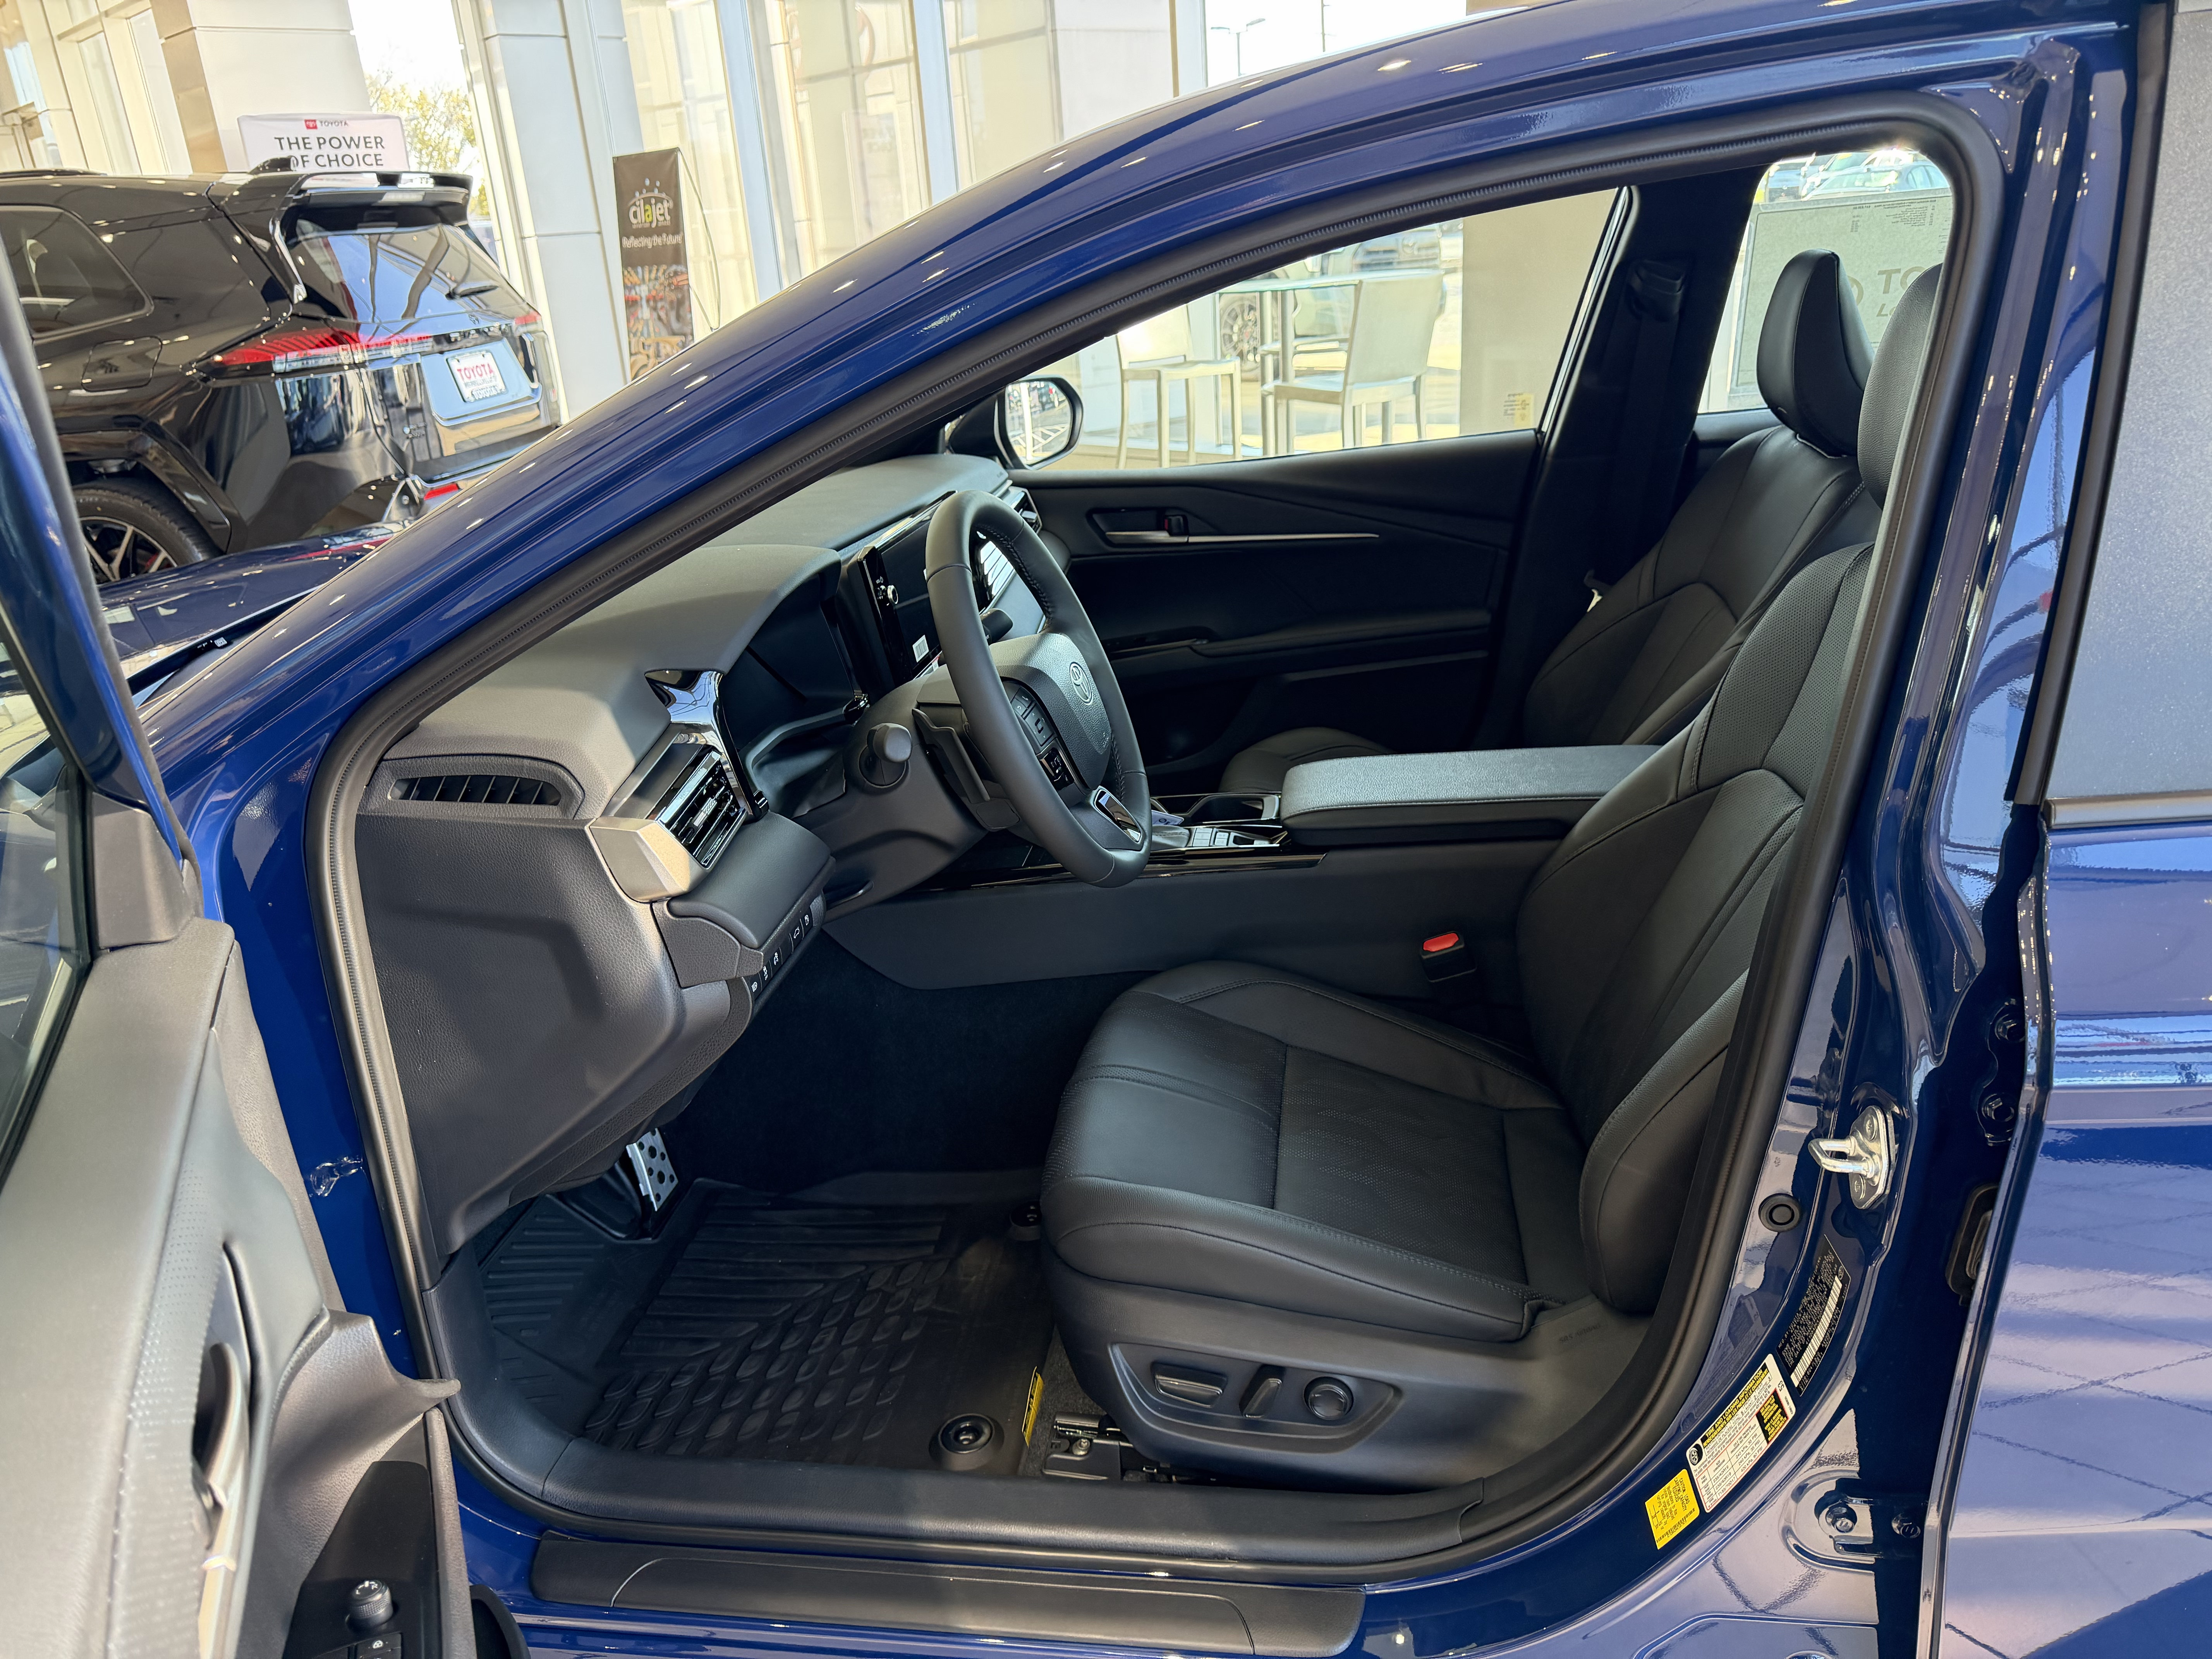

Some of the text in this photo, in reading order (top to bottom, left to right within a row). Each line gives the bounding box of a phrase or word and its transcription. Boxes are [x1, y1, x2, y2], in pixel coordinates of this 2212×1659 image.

[274, 136, 385, 150] THE POWER
[315, 153, 383, 167] CHOICE
[457, 363, 495, 381] TOYOTA
[1705, 1369, 1763, 1439] TIRE AND LOADING INFORMATION
